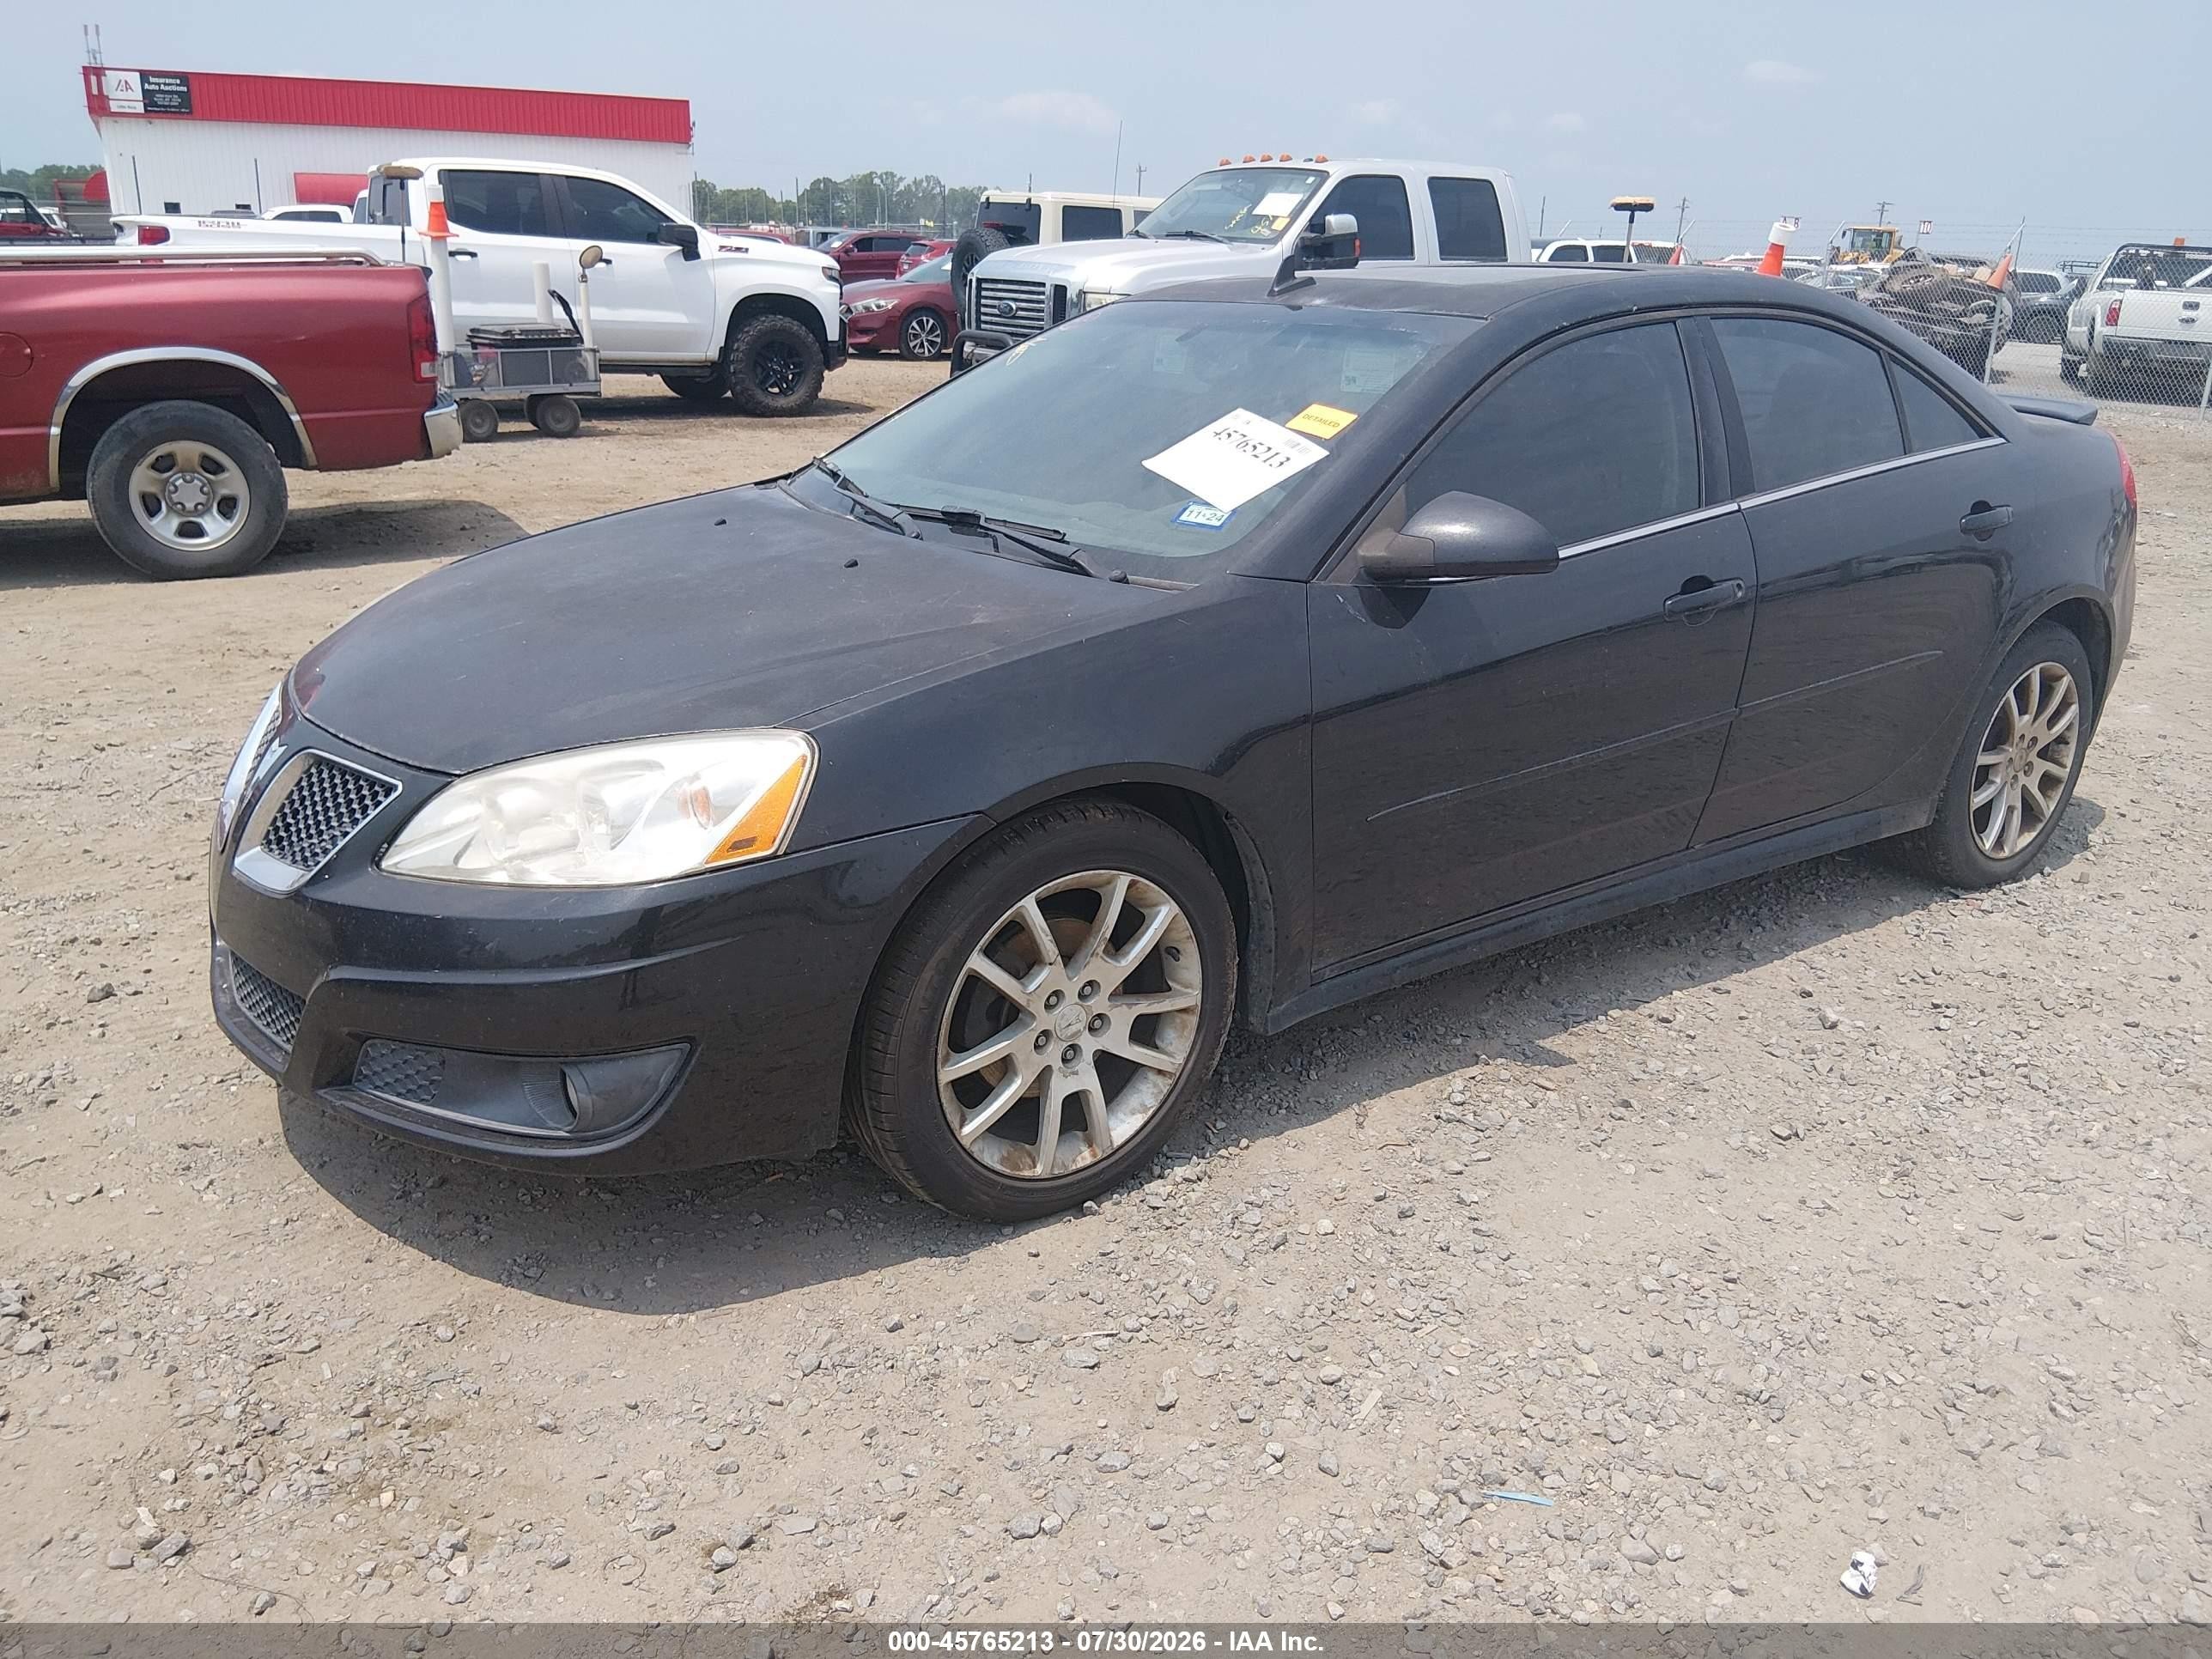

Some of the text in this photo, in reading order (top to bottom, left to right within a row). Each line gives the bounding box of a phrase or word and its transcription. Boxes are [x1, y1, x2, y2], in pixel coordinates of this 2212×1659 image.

[149, 76, 180, 84] Insurance
[1303, 413, 1340, 428] DETAILED
[1212, 427, 1291, 468] 45765213
